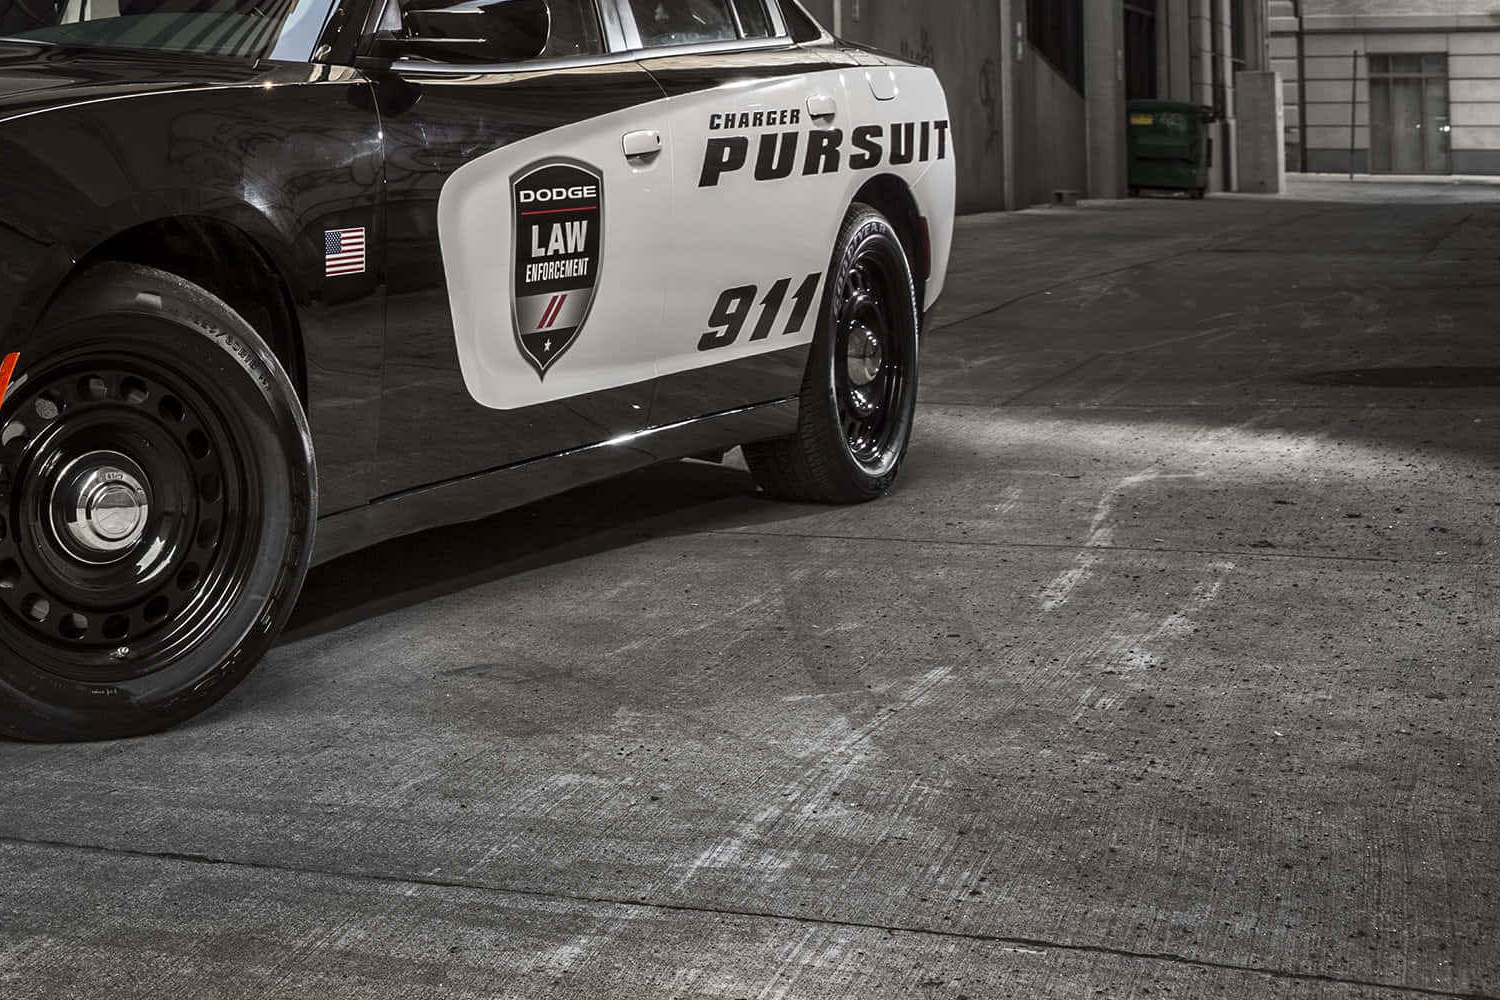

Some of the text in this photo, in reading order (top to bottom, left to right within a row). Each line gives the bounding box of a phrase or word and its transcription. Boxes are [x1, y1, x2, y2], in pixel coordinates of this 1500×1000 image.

[709, 109, 800, 130] CHARGER
[698, 120, 948, 188] PURSUIT
[519, 185, 597, 203] DODGE
[531, 220, 588, 258] LAW
[525, 257, 589, 283] ENFORCEMENT
[697, 271, 822, 352] 911
